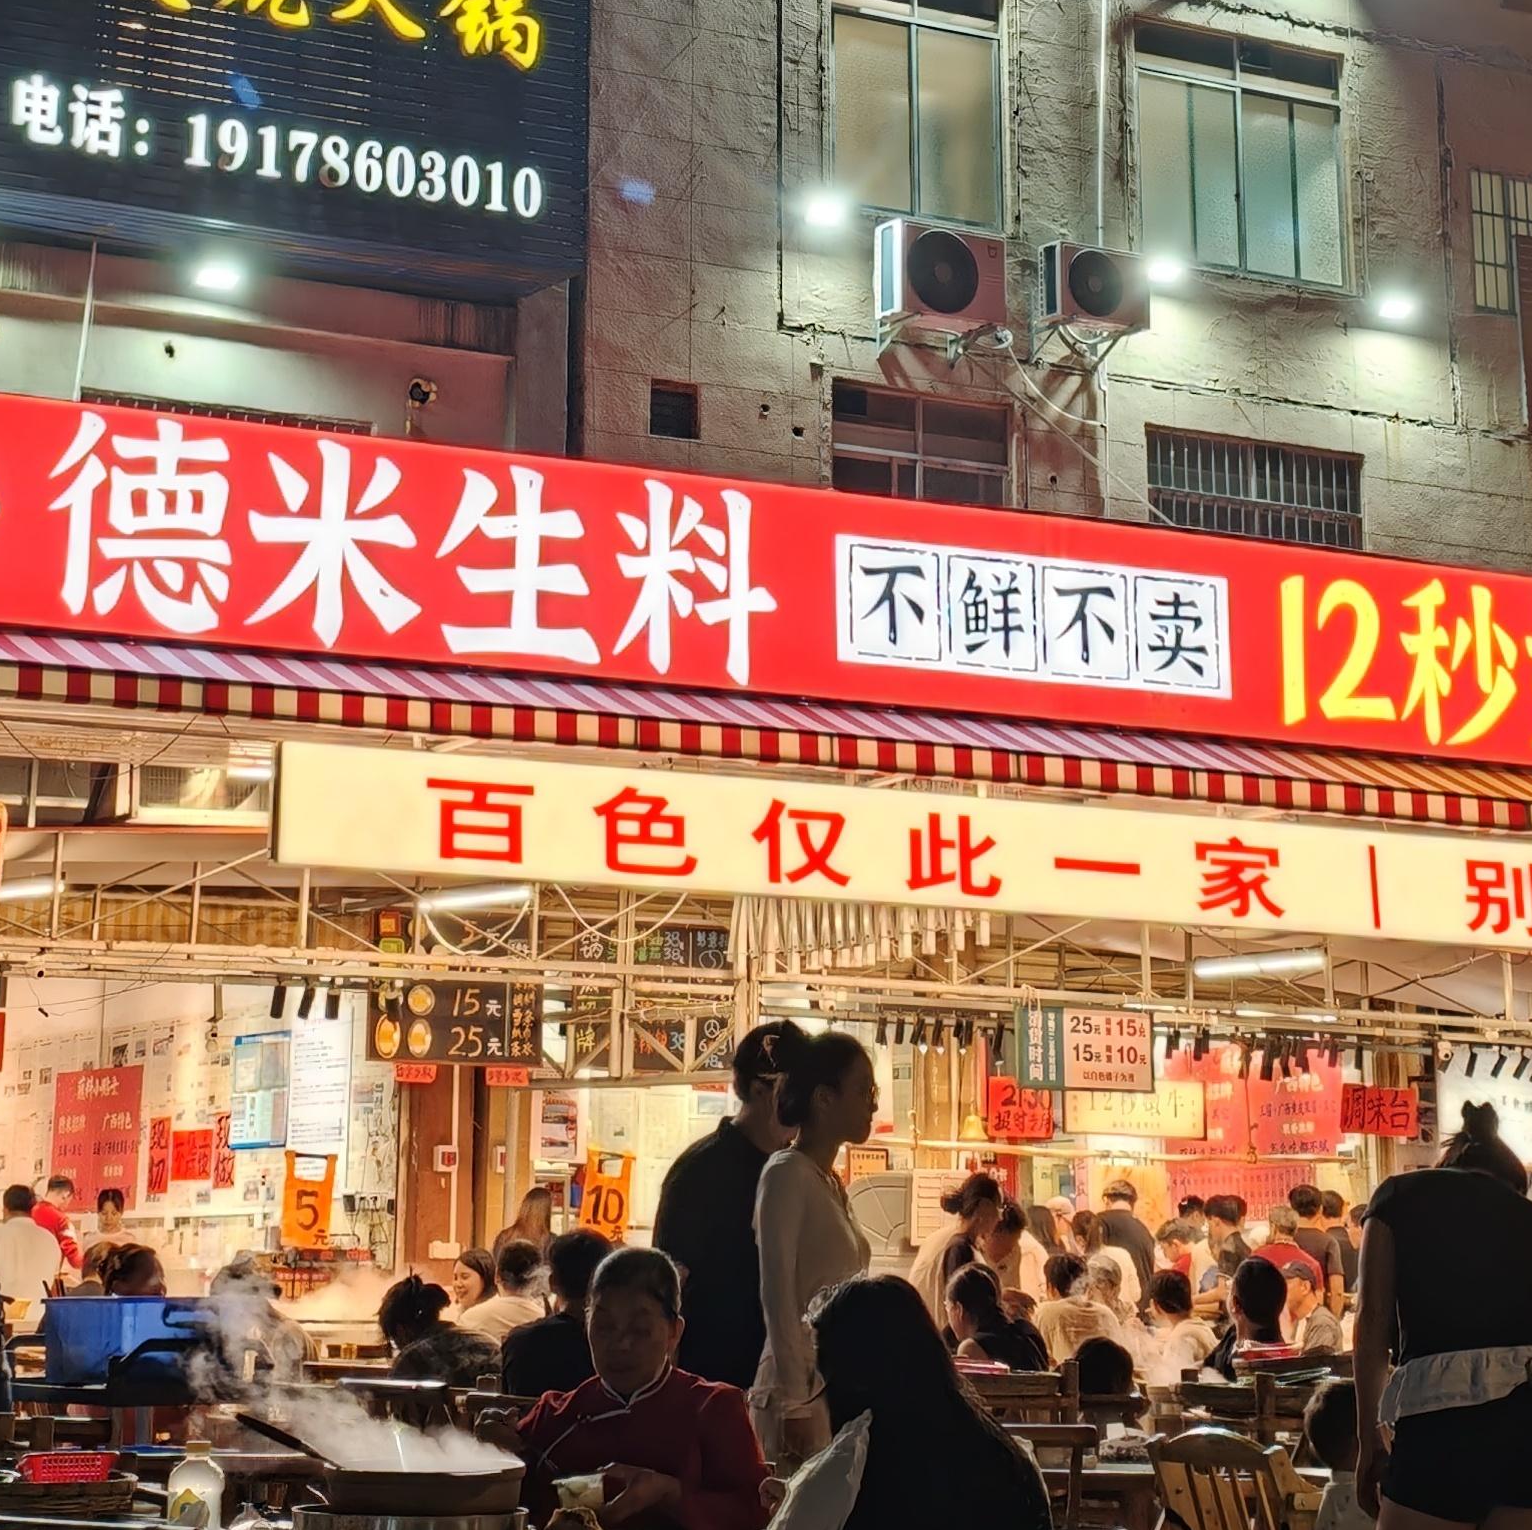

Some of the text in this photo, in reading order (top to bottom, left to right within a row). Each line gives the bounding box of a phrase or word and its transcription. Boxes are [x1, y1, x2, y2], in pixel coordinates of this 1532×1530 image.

[49, 410, 777, 686] 德米生料
[859, 564, 1208, 678] 不鲜不卖
[426, 776, 1291, 918] 百色仅此一家
[452, 988, 503, 1018] 15元
[448, 1025, 504, 1058] 25元
[1069, 1015, 1102, 1035] 25元
[1072, 1043, 1102, 1063] 15元
[1116, 1045, 1148, 1065] 10元
[1345, 1087, 1410, 1129] 调味台
